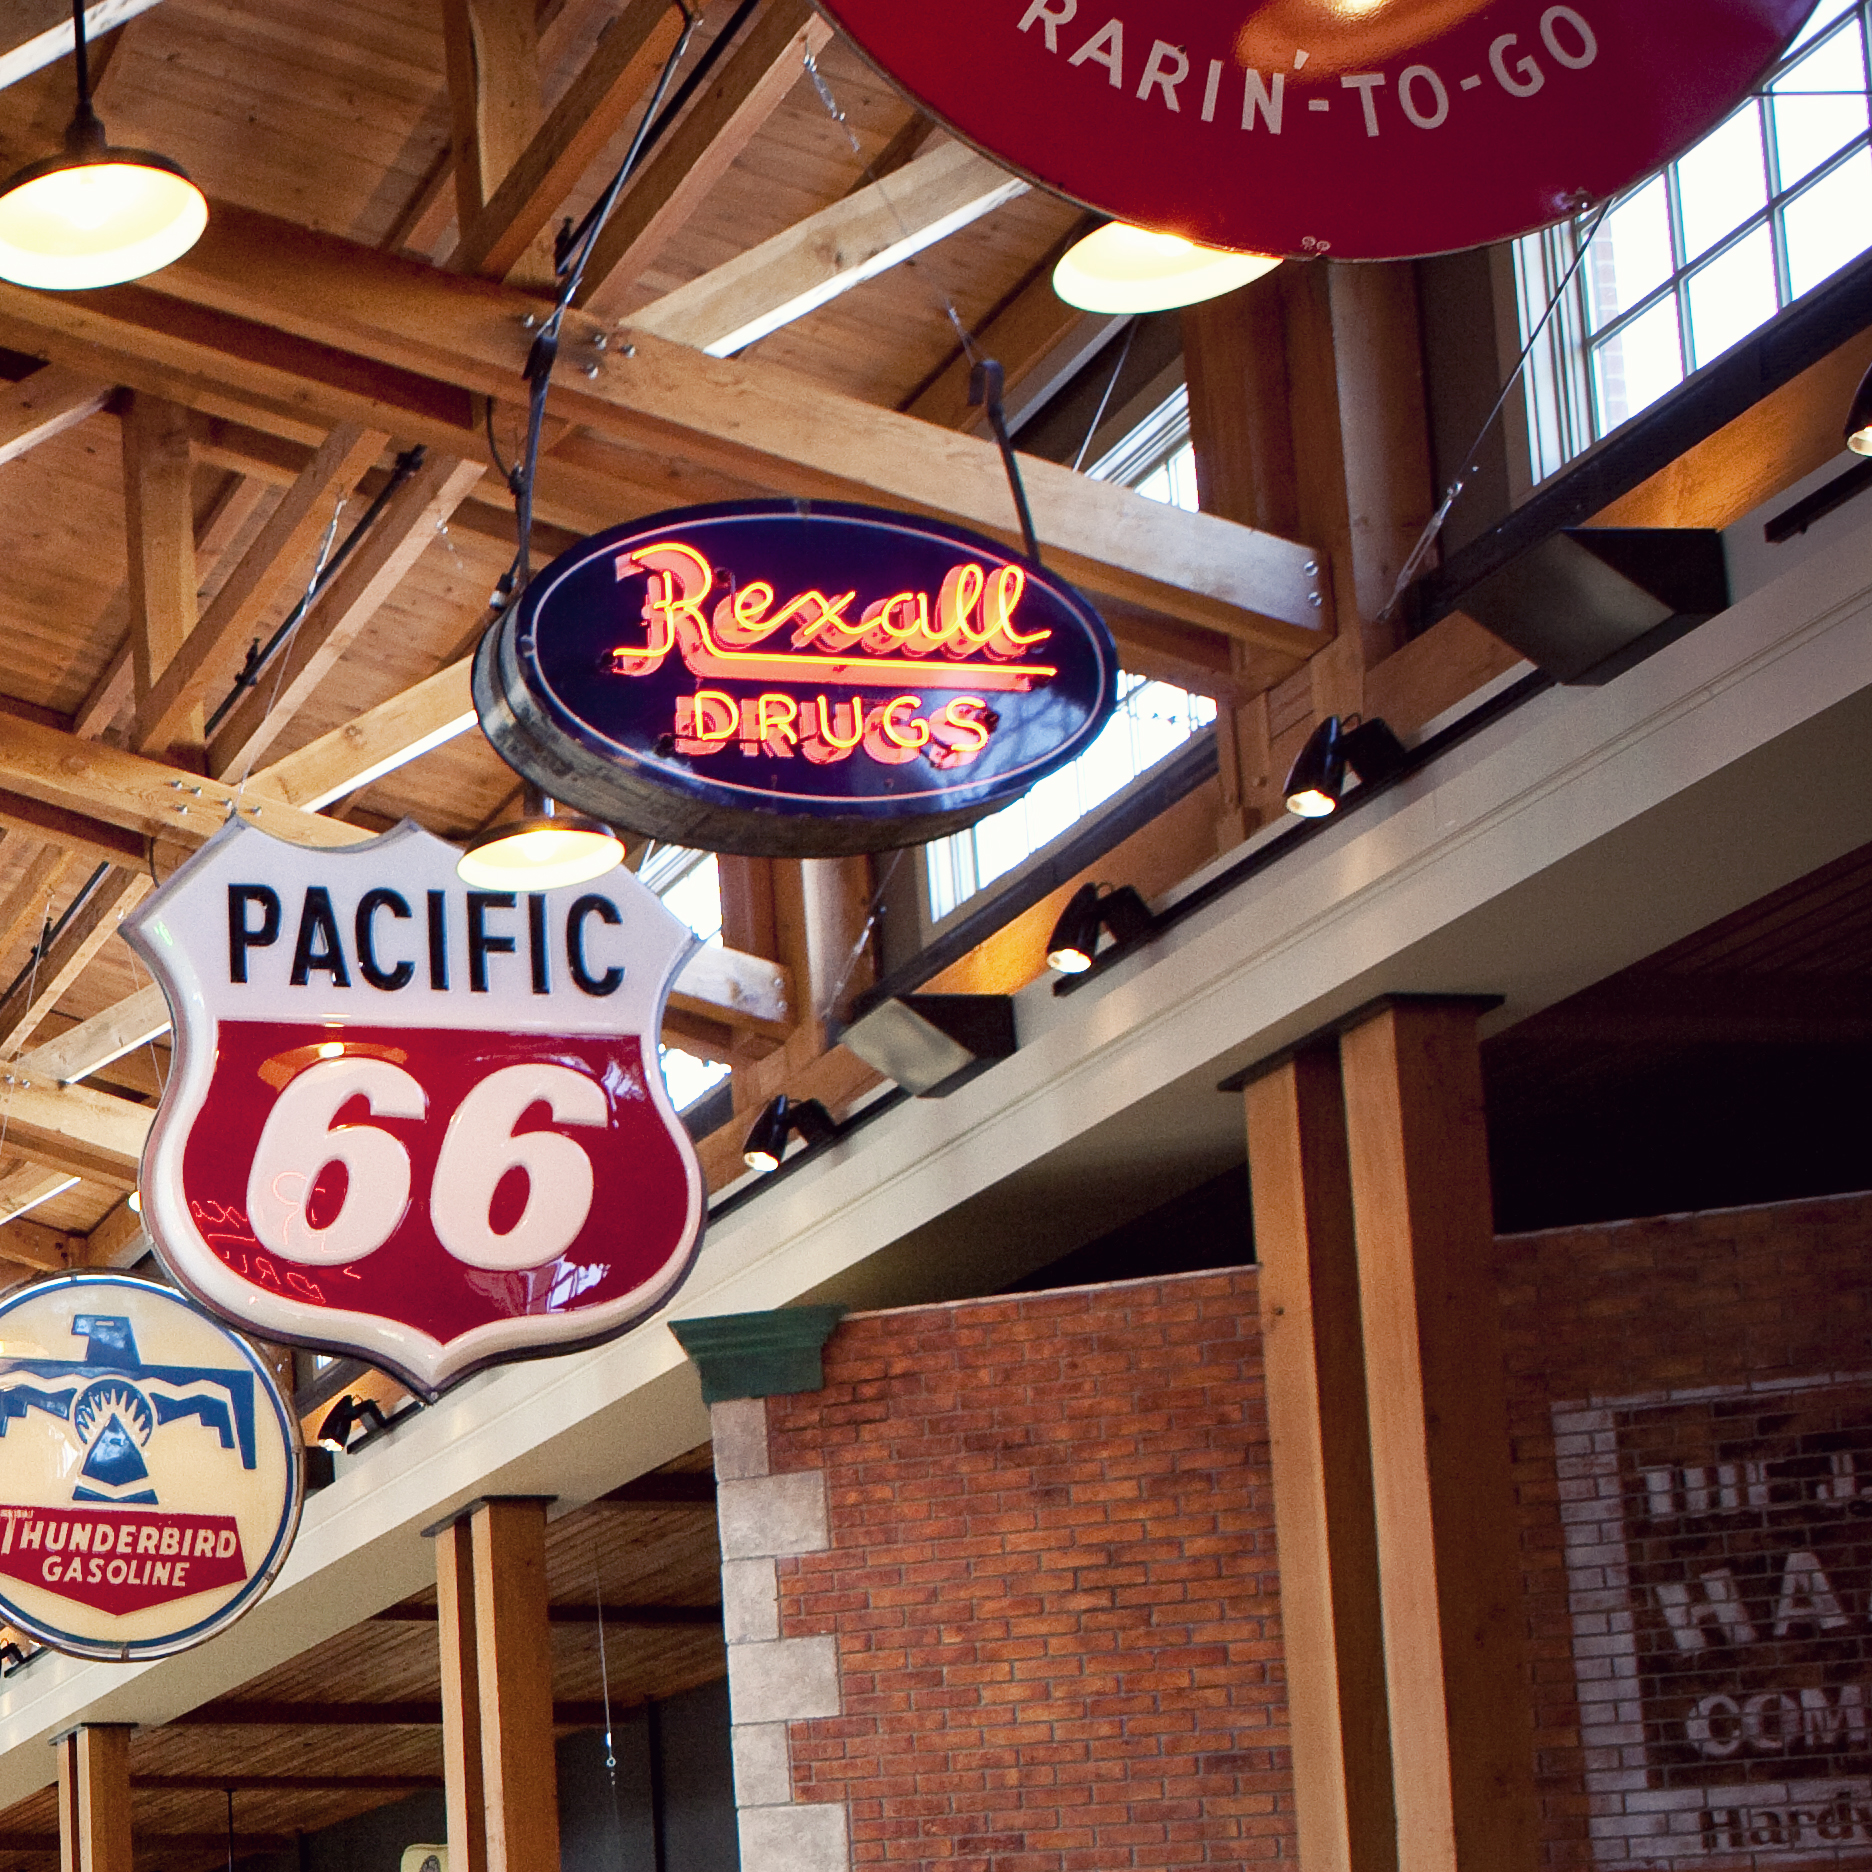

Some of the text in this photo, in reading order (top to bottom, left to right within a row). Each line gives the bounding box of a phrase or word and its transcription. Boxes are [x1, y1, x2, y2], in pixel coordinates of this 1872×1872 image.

[1016, 0, 1601, 139] RARIN'-TO-GO
[611, 541, 1056, 688] Rexall
[668, 689, 994, 770] DRUGS
[226, 882, 628, 998] PACIFIC
[246, 1055, 609, 1271] 66
[41, 1555, 191, 1588] GASOLINE
